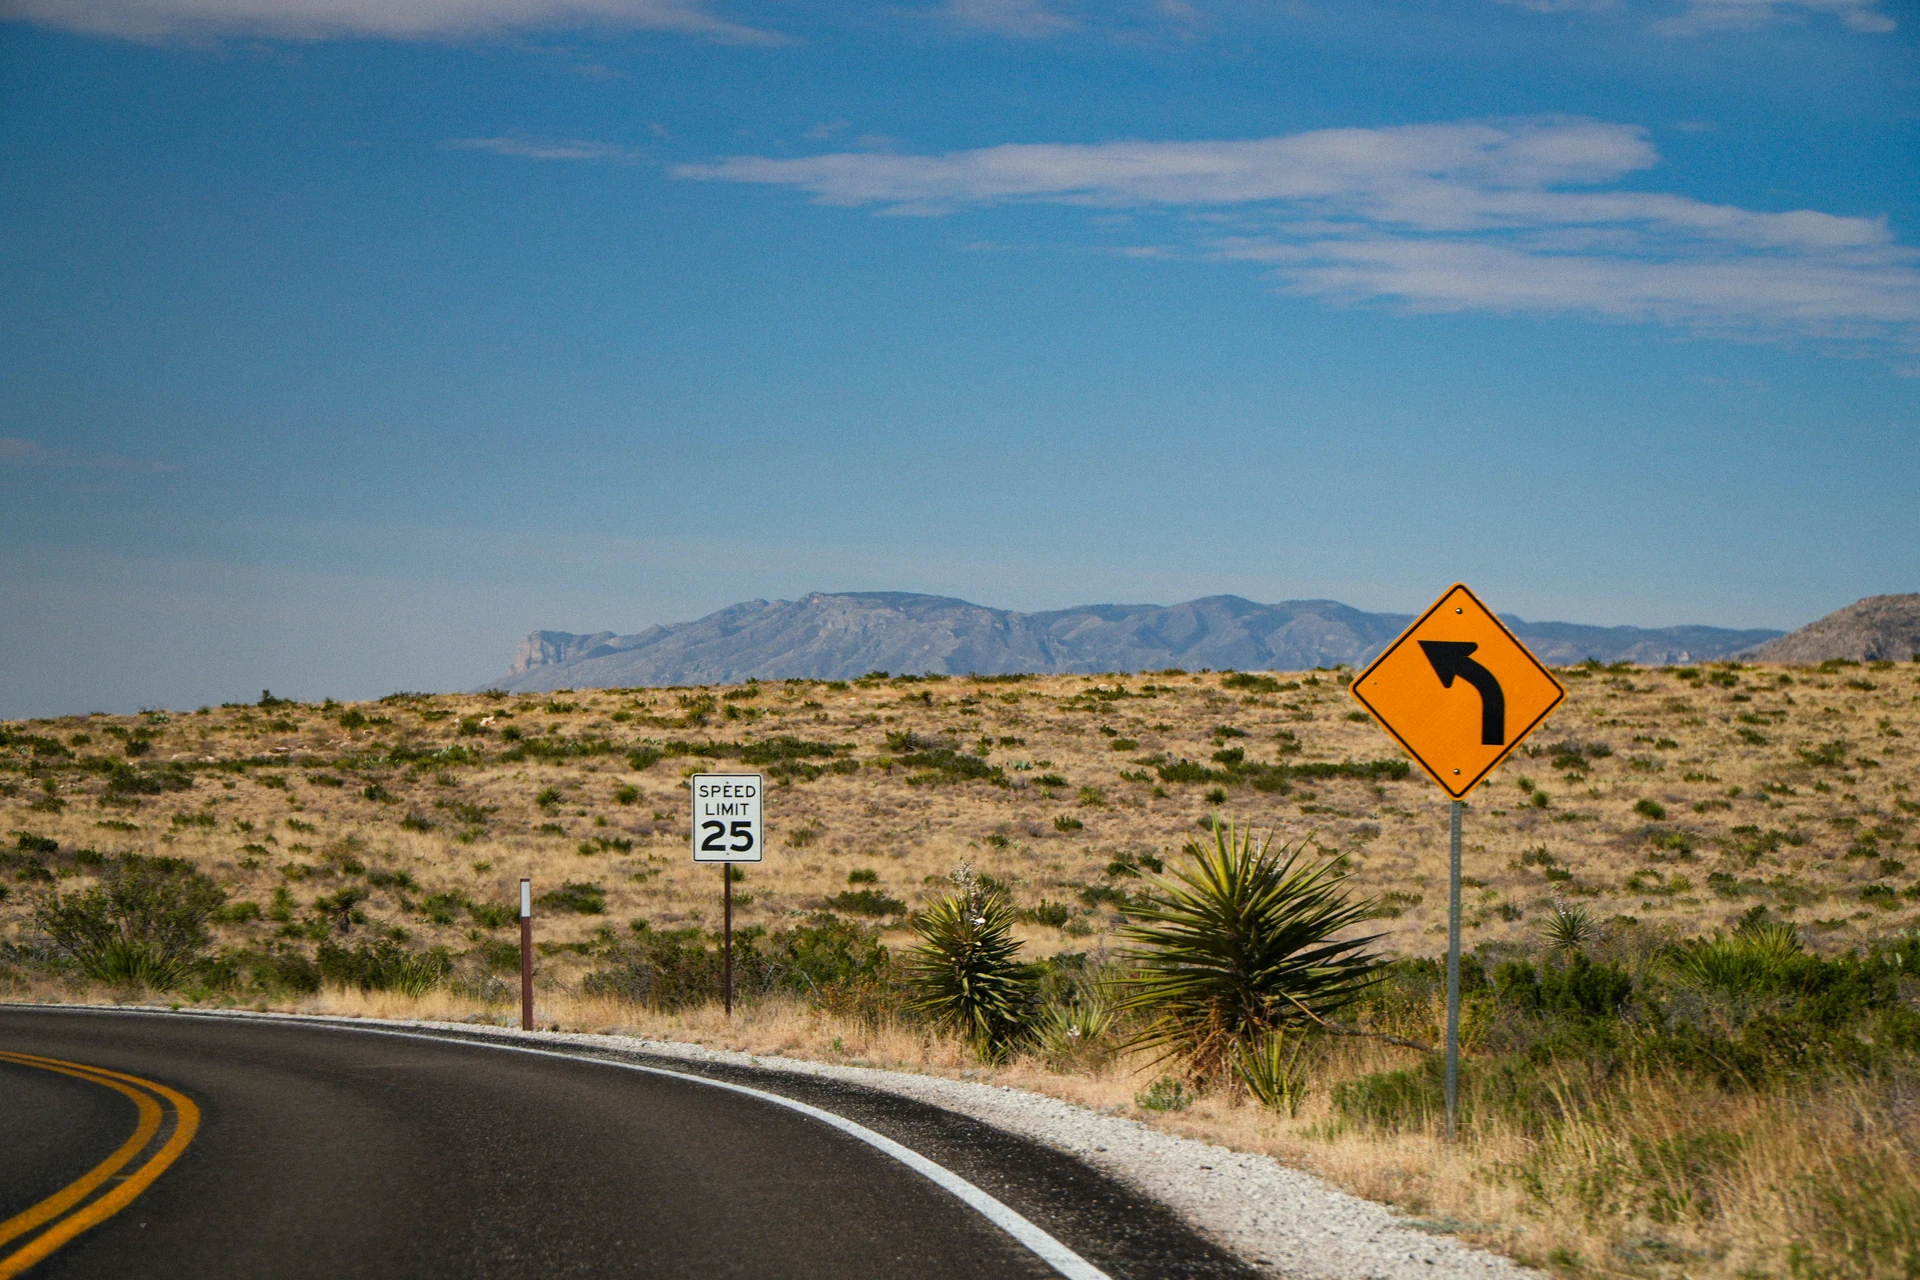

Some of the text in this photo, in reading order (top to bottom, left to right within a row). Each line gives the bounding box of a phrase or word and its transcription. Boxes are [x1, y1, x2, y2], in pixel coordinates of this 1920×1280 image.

[699, 785, 756, 798] SPEED
[705, 803, 749, 815] LIMIT
[701, 820, 754, 852] 25
